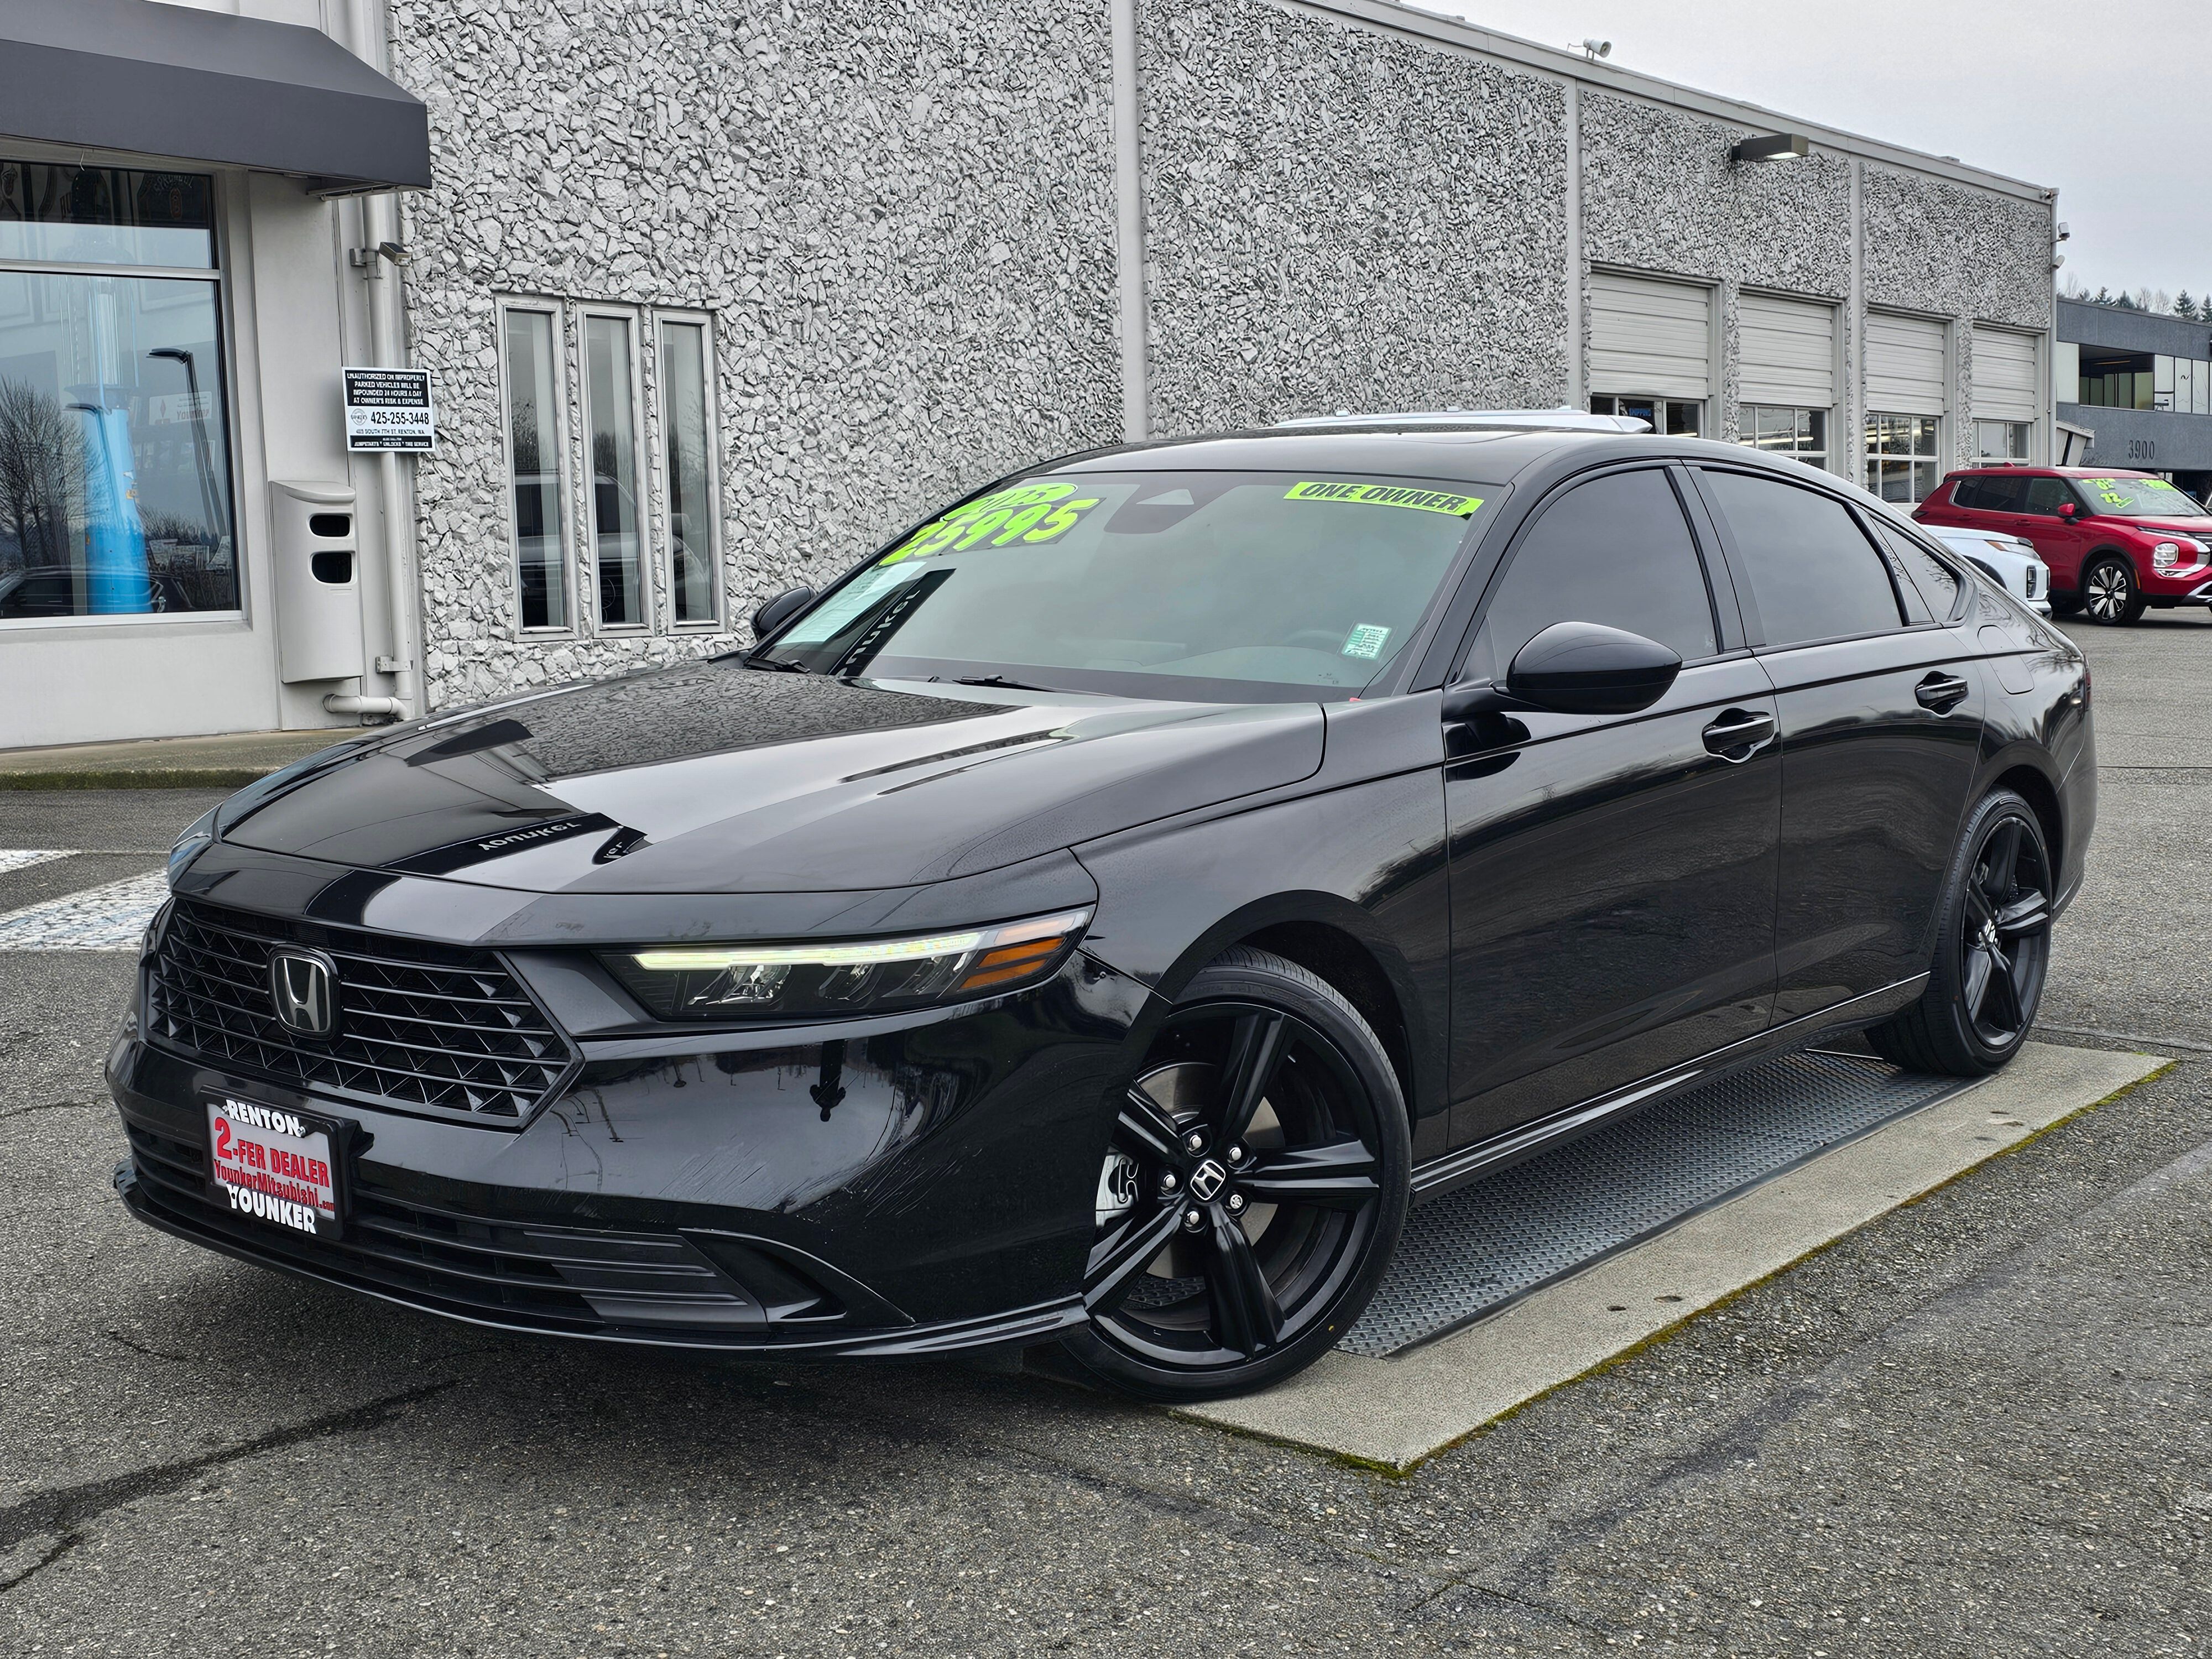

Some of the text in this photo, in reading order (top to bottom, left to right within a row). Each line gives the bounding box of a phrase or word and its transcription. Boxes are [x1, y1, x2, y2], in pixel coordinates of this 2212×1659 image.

[371, 411, 429, 425] 425-255-3448
[2129, 440, 2154, 460] 3900
[1299, 483, 1469, 512] ONE OWNER
[878, 498, 1100, 565] 25995
[226, 1099, 301, 1138] RENTON
[215, 1117, 330, 1188] 2-FER DEALER
[226, 1183, 317, 1234] YOUNKER
